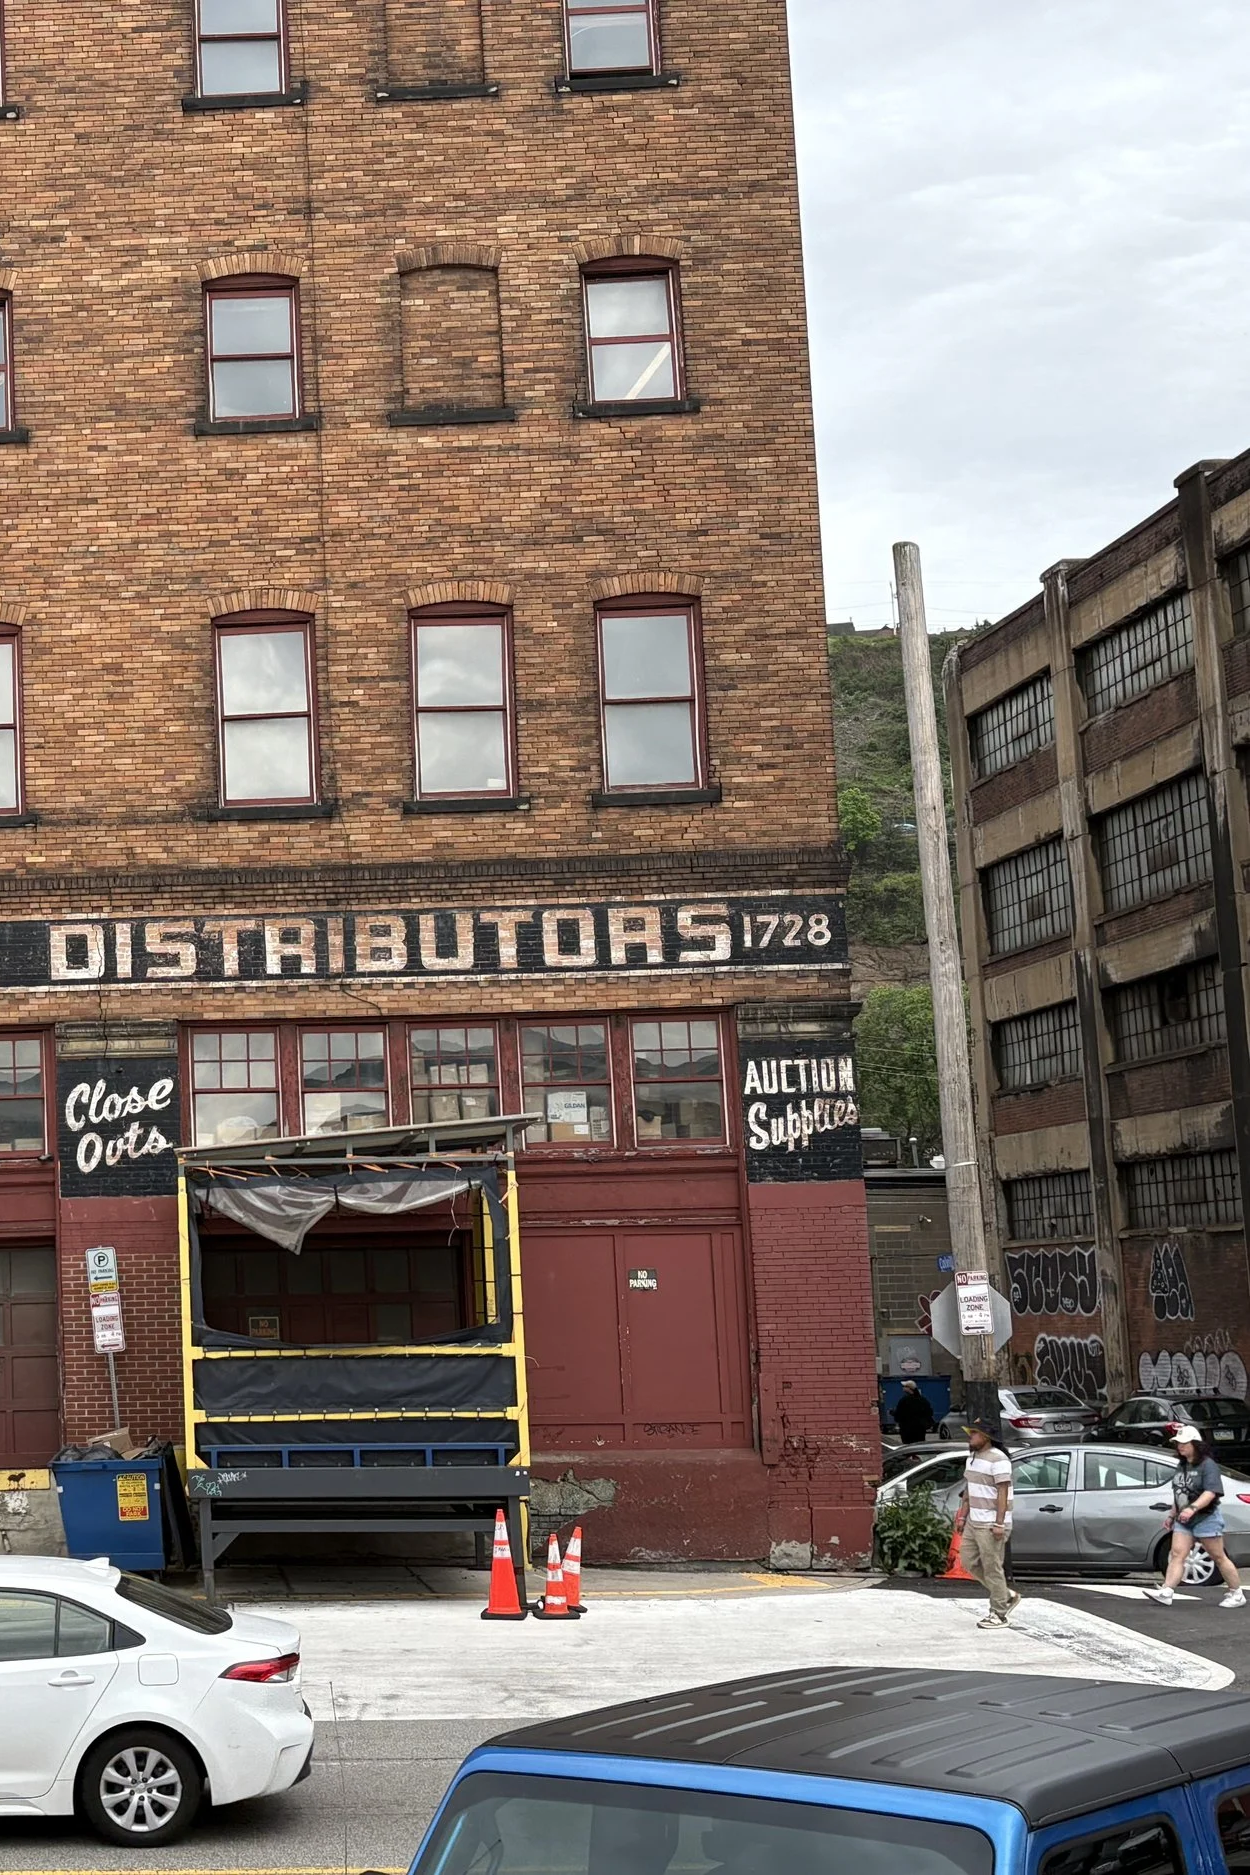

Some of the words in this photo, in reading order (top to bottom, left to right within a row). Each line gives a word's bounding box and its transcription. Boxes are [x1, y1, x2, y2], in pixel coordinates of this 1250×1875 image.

[49, 904, 732, 981] DISTRIBUTORS
[742, 913, 832, 948] 1728
[744, 1057, 855, 1095] AUCTION
[65, 1078, 174, 1132] Close
[747, 1096, 860, 1152] Supplies
[76, 1121, 174, 1174] Outs
[629, 1279, 657, 1288] PARKING
[637, 1270, 648, 1279] NO
[956, 1273, 967, 1284] NO
[95, 1315, 119, 1323] LOADING
